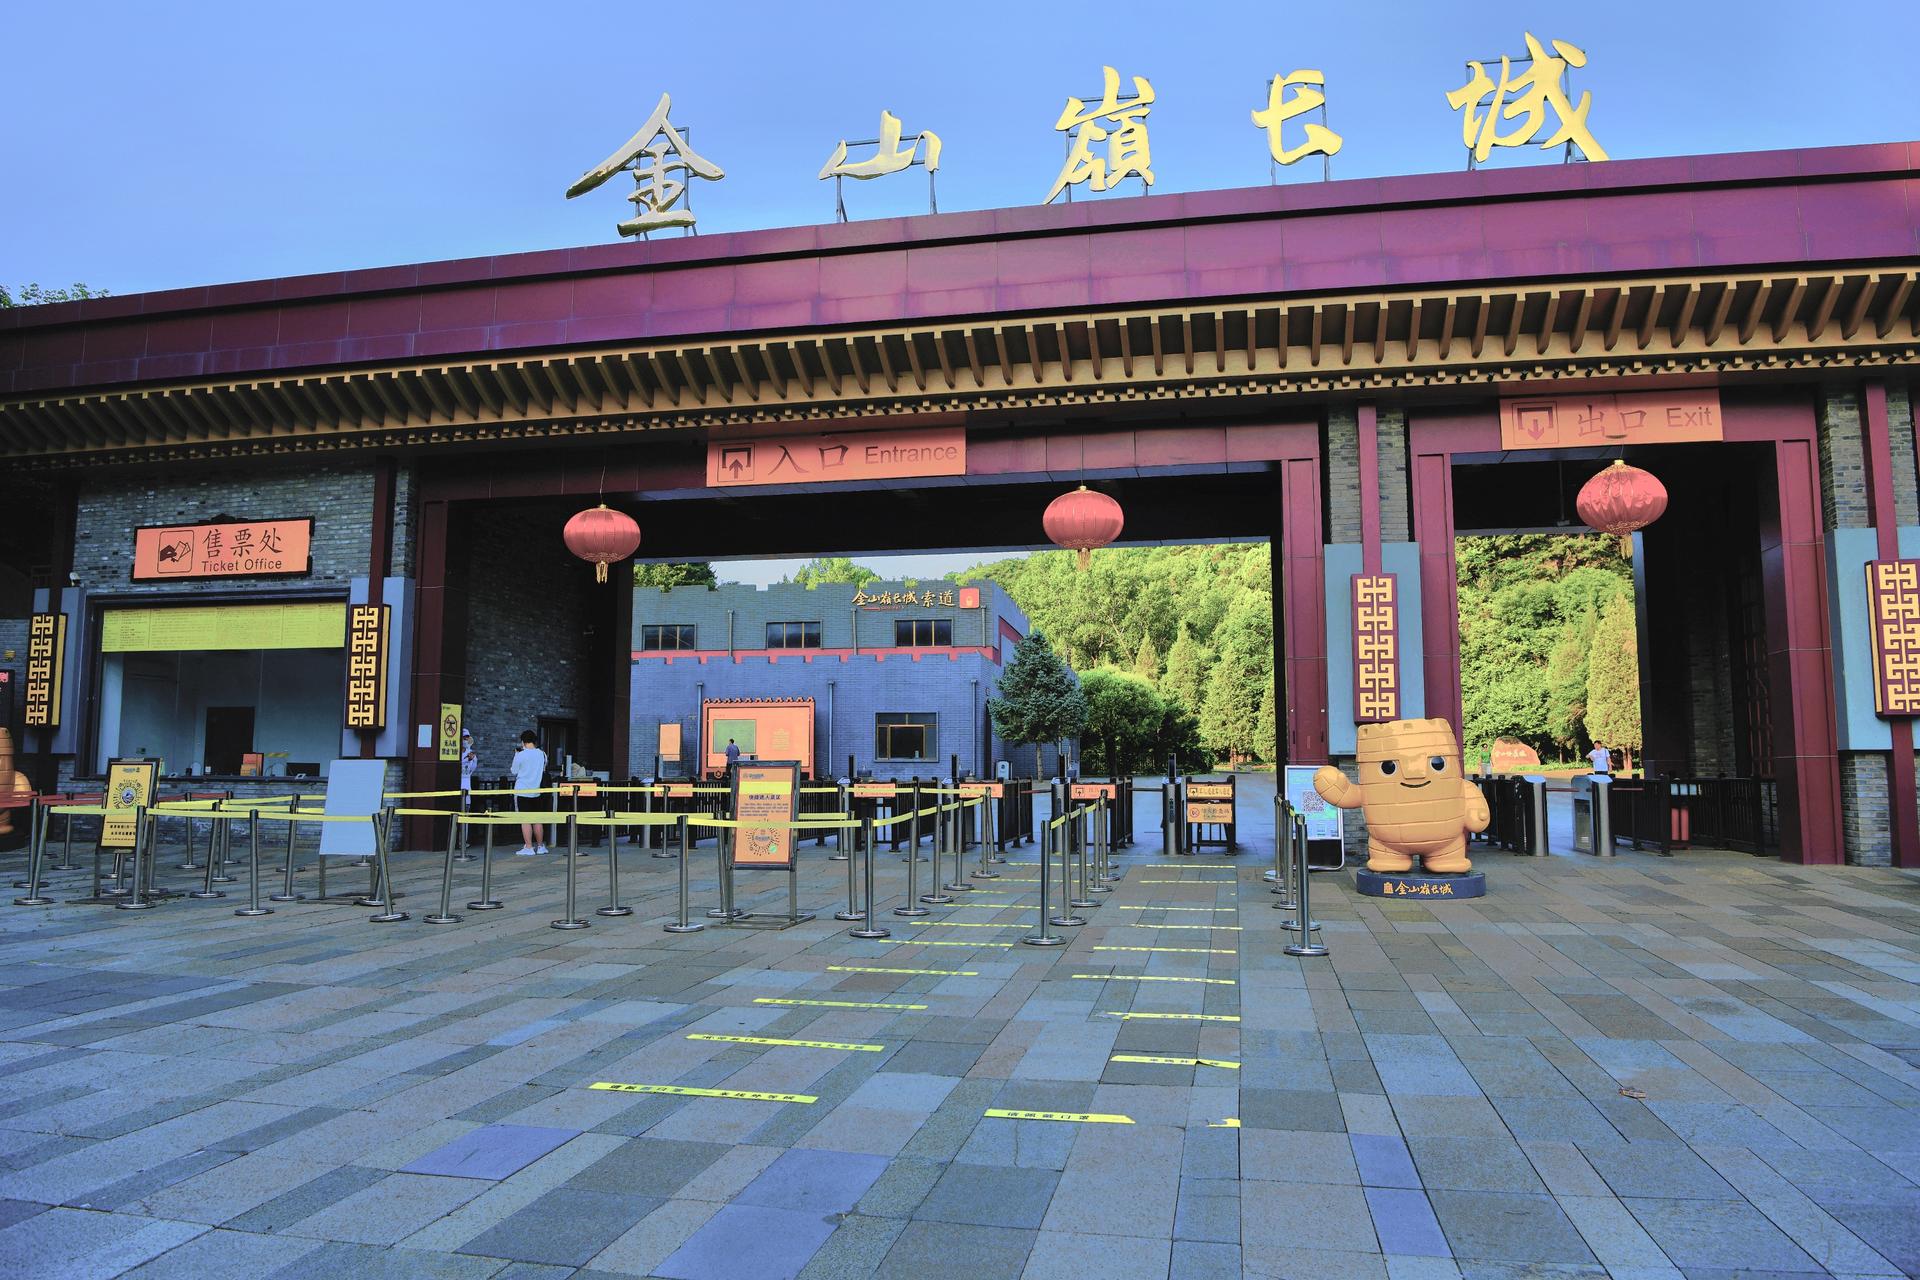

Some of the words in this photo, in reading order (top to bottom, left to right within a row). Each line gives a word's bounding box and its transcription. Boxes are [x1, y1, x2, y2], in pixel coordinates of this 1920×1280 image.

[1578, 405, 1647, 438] 出口
[1666, 407, 1713, 427] Exit
[768, 445, 849, 475] 入口
[865, 444, 957, 465] Entrance
[202, 528, 283, 559] 售票处
[202, 560, 239, 573] Ticket
[244, 559, 283, 571] Office
